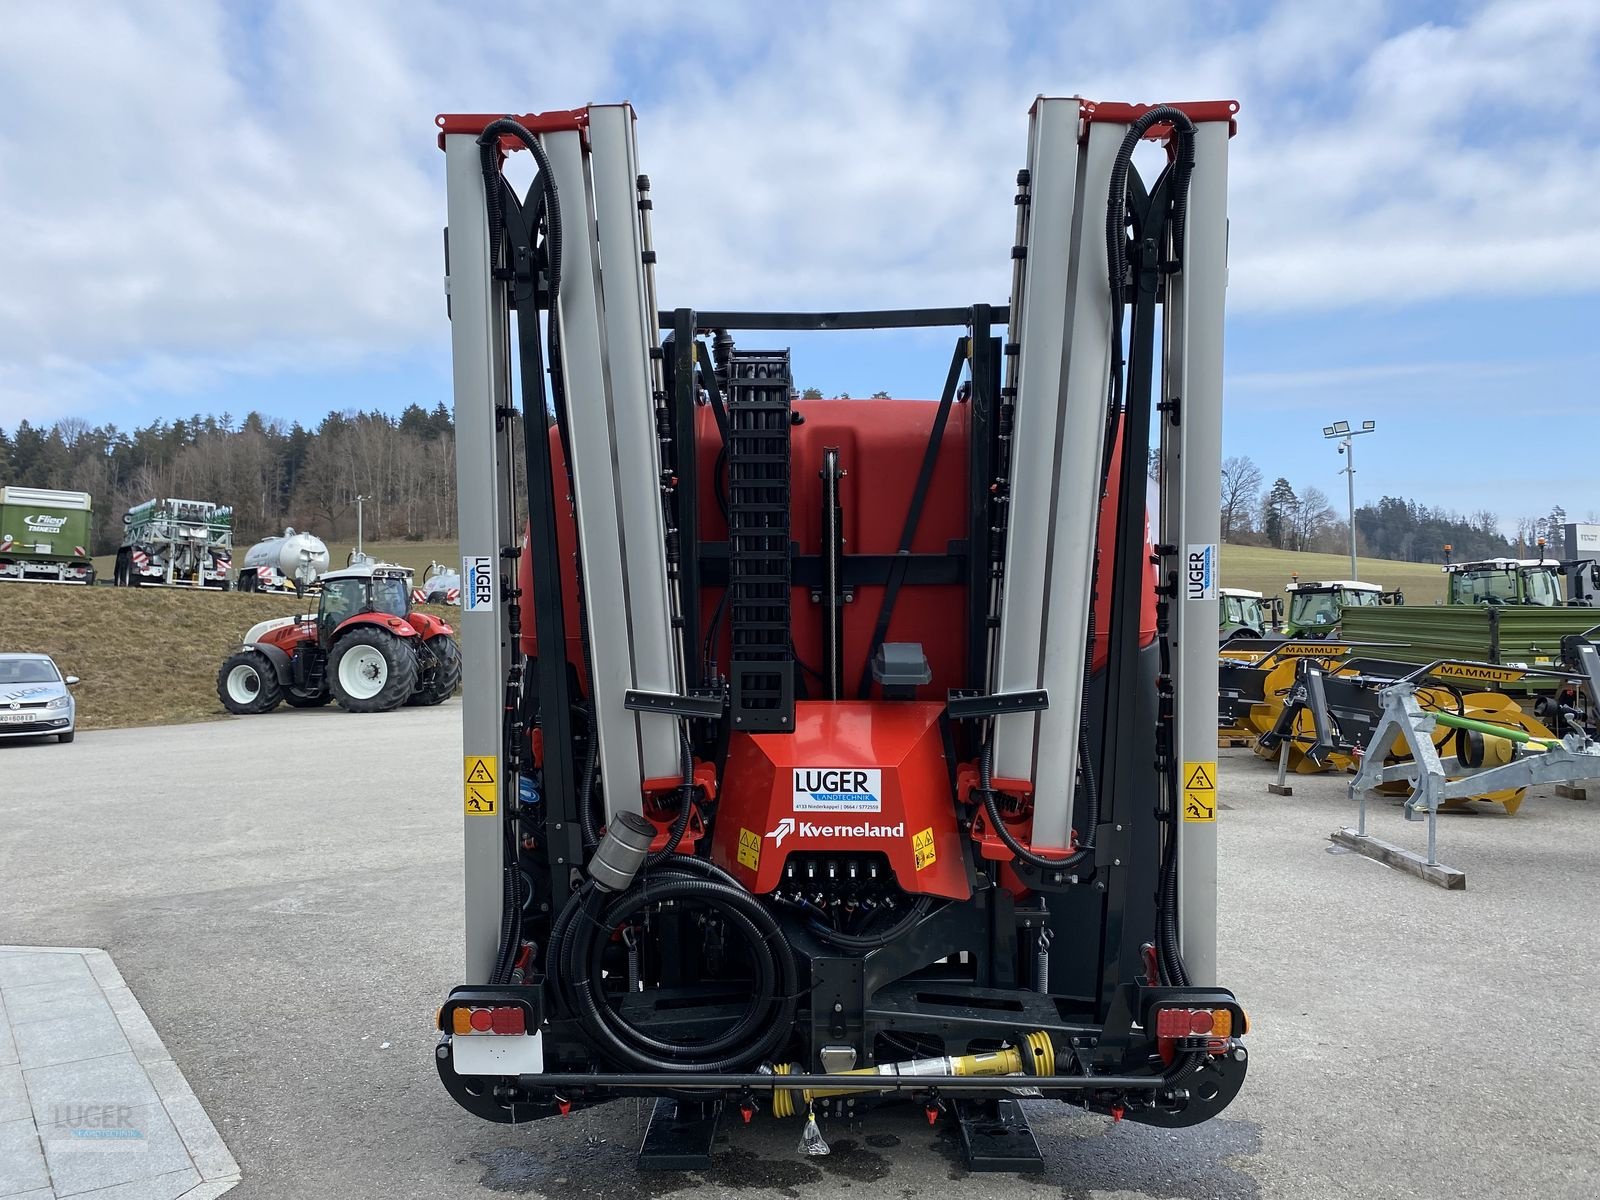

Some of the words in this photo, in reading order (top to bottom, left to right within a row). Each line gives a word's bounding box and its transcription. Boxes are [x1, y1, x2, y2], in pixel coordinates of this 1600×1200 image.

[37, 515, 68, 527] Fliegl
[475, 557, 491, 604] LUGER
[1189, 552, 1204, 599] LUGER
[1441, 666, 1512, 680] MAMMUT
[4, 687, 48, 700] LUGER
[795, 771, 870, 793] LUGER
[799, 822, 905, 837] Kverneland
